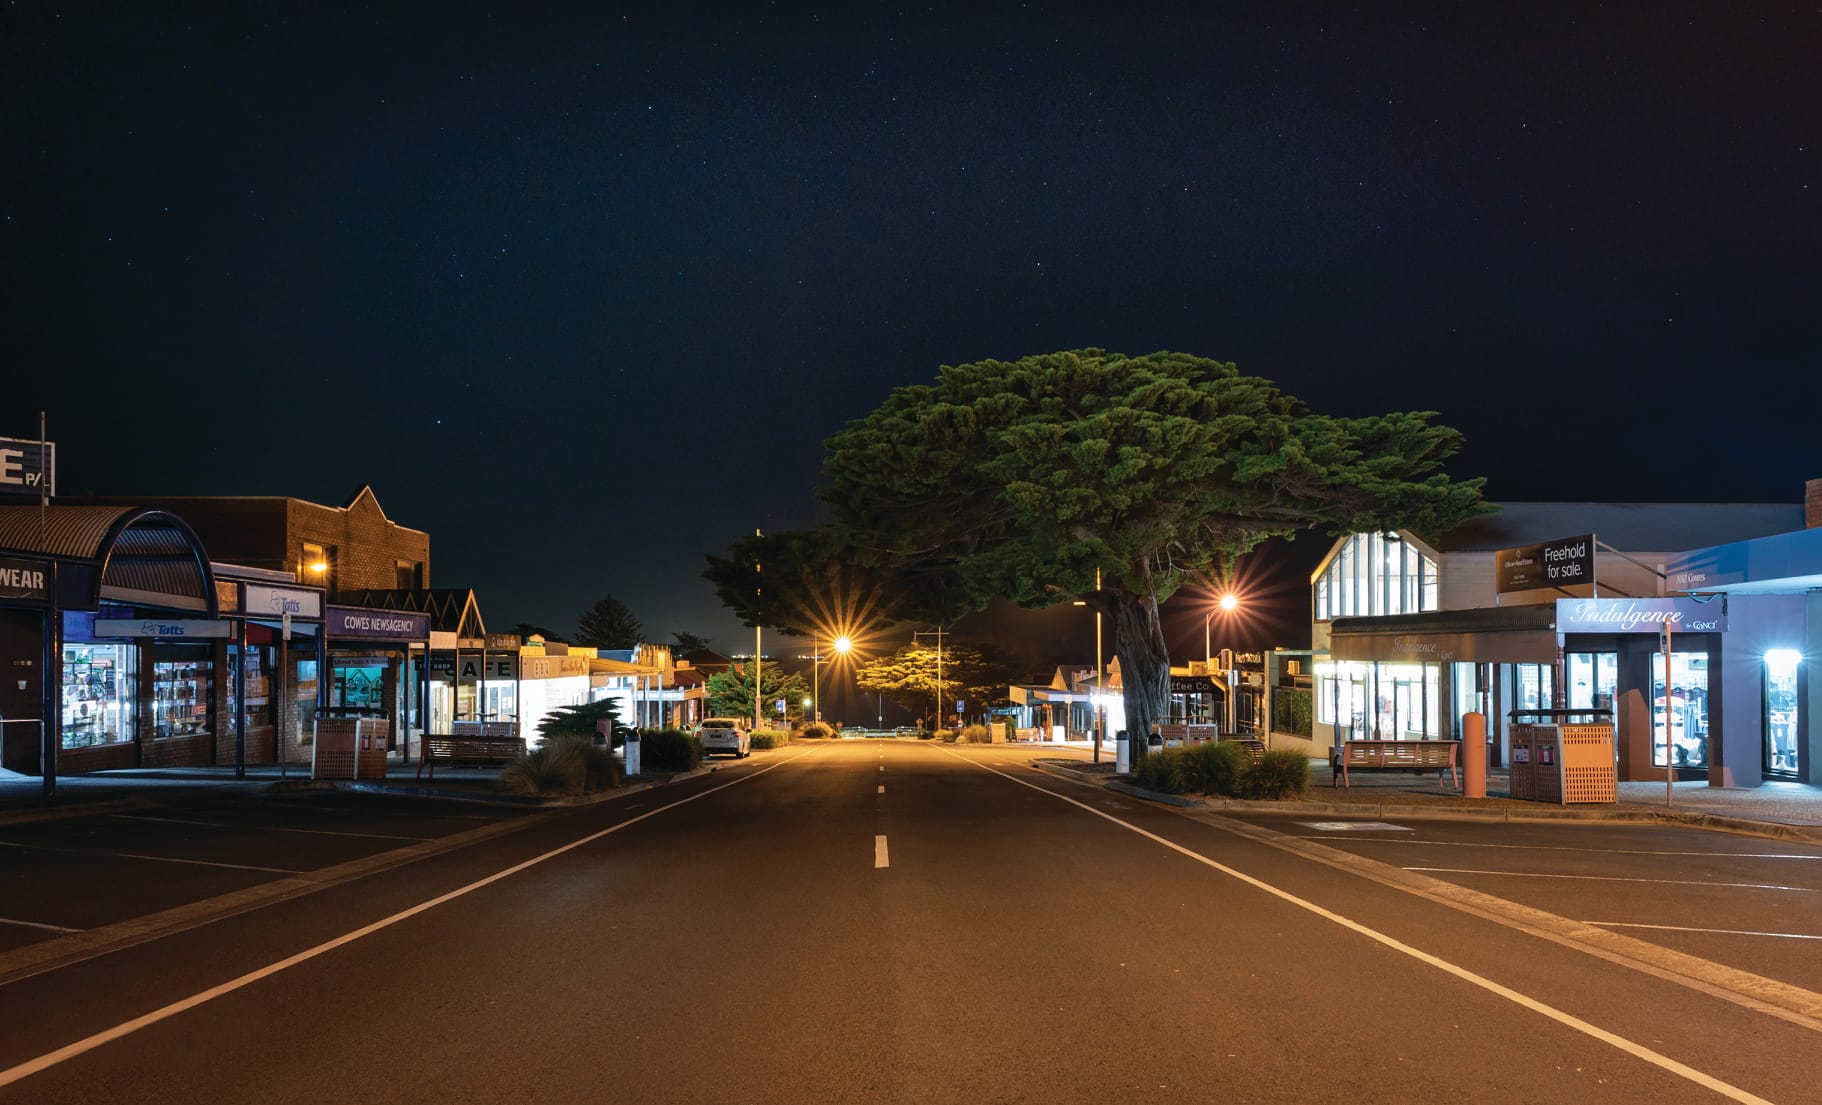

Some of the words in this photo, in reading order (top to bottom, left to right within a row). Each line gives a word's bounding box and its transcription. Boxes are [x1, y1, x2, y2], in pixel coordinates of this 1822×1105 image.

[1544, 543, 1586, 563] Freehold
[0, 567, 44, 589] WEAR
[1548, 564, 1560, 579] for
[1562, 563, 1583, 577] sale.
[281, 597, 300, 613] Tatts
[344, 616, 370, 630] COWES
[371, 618, 414, 633] NEWSAGENCY
[1570, 602, 1684, 630] Indulgence
[157, 624, 185, 636] Tatts
